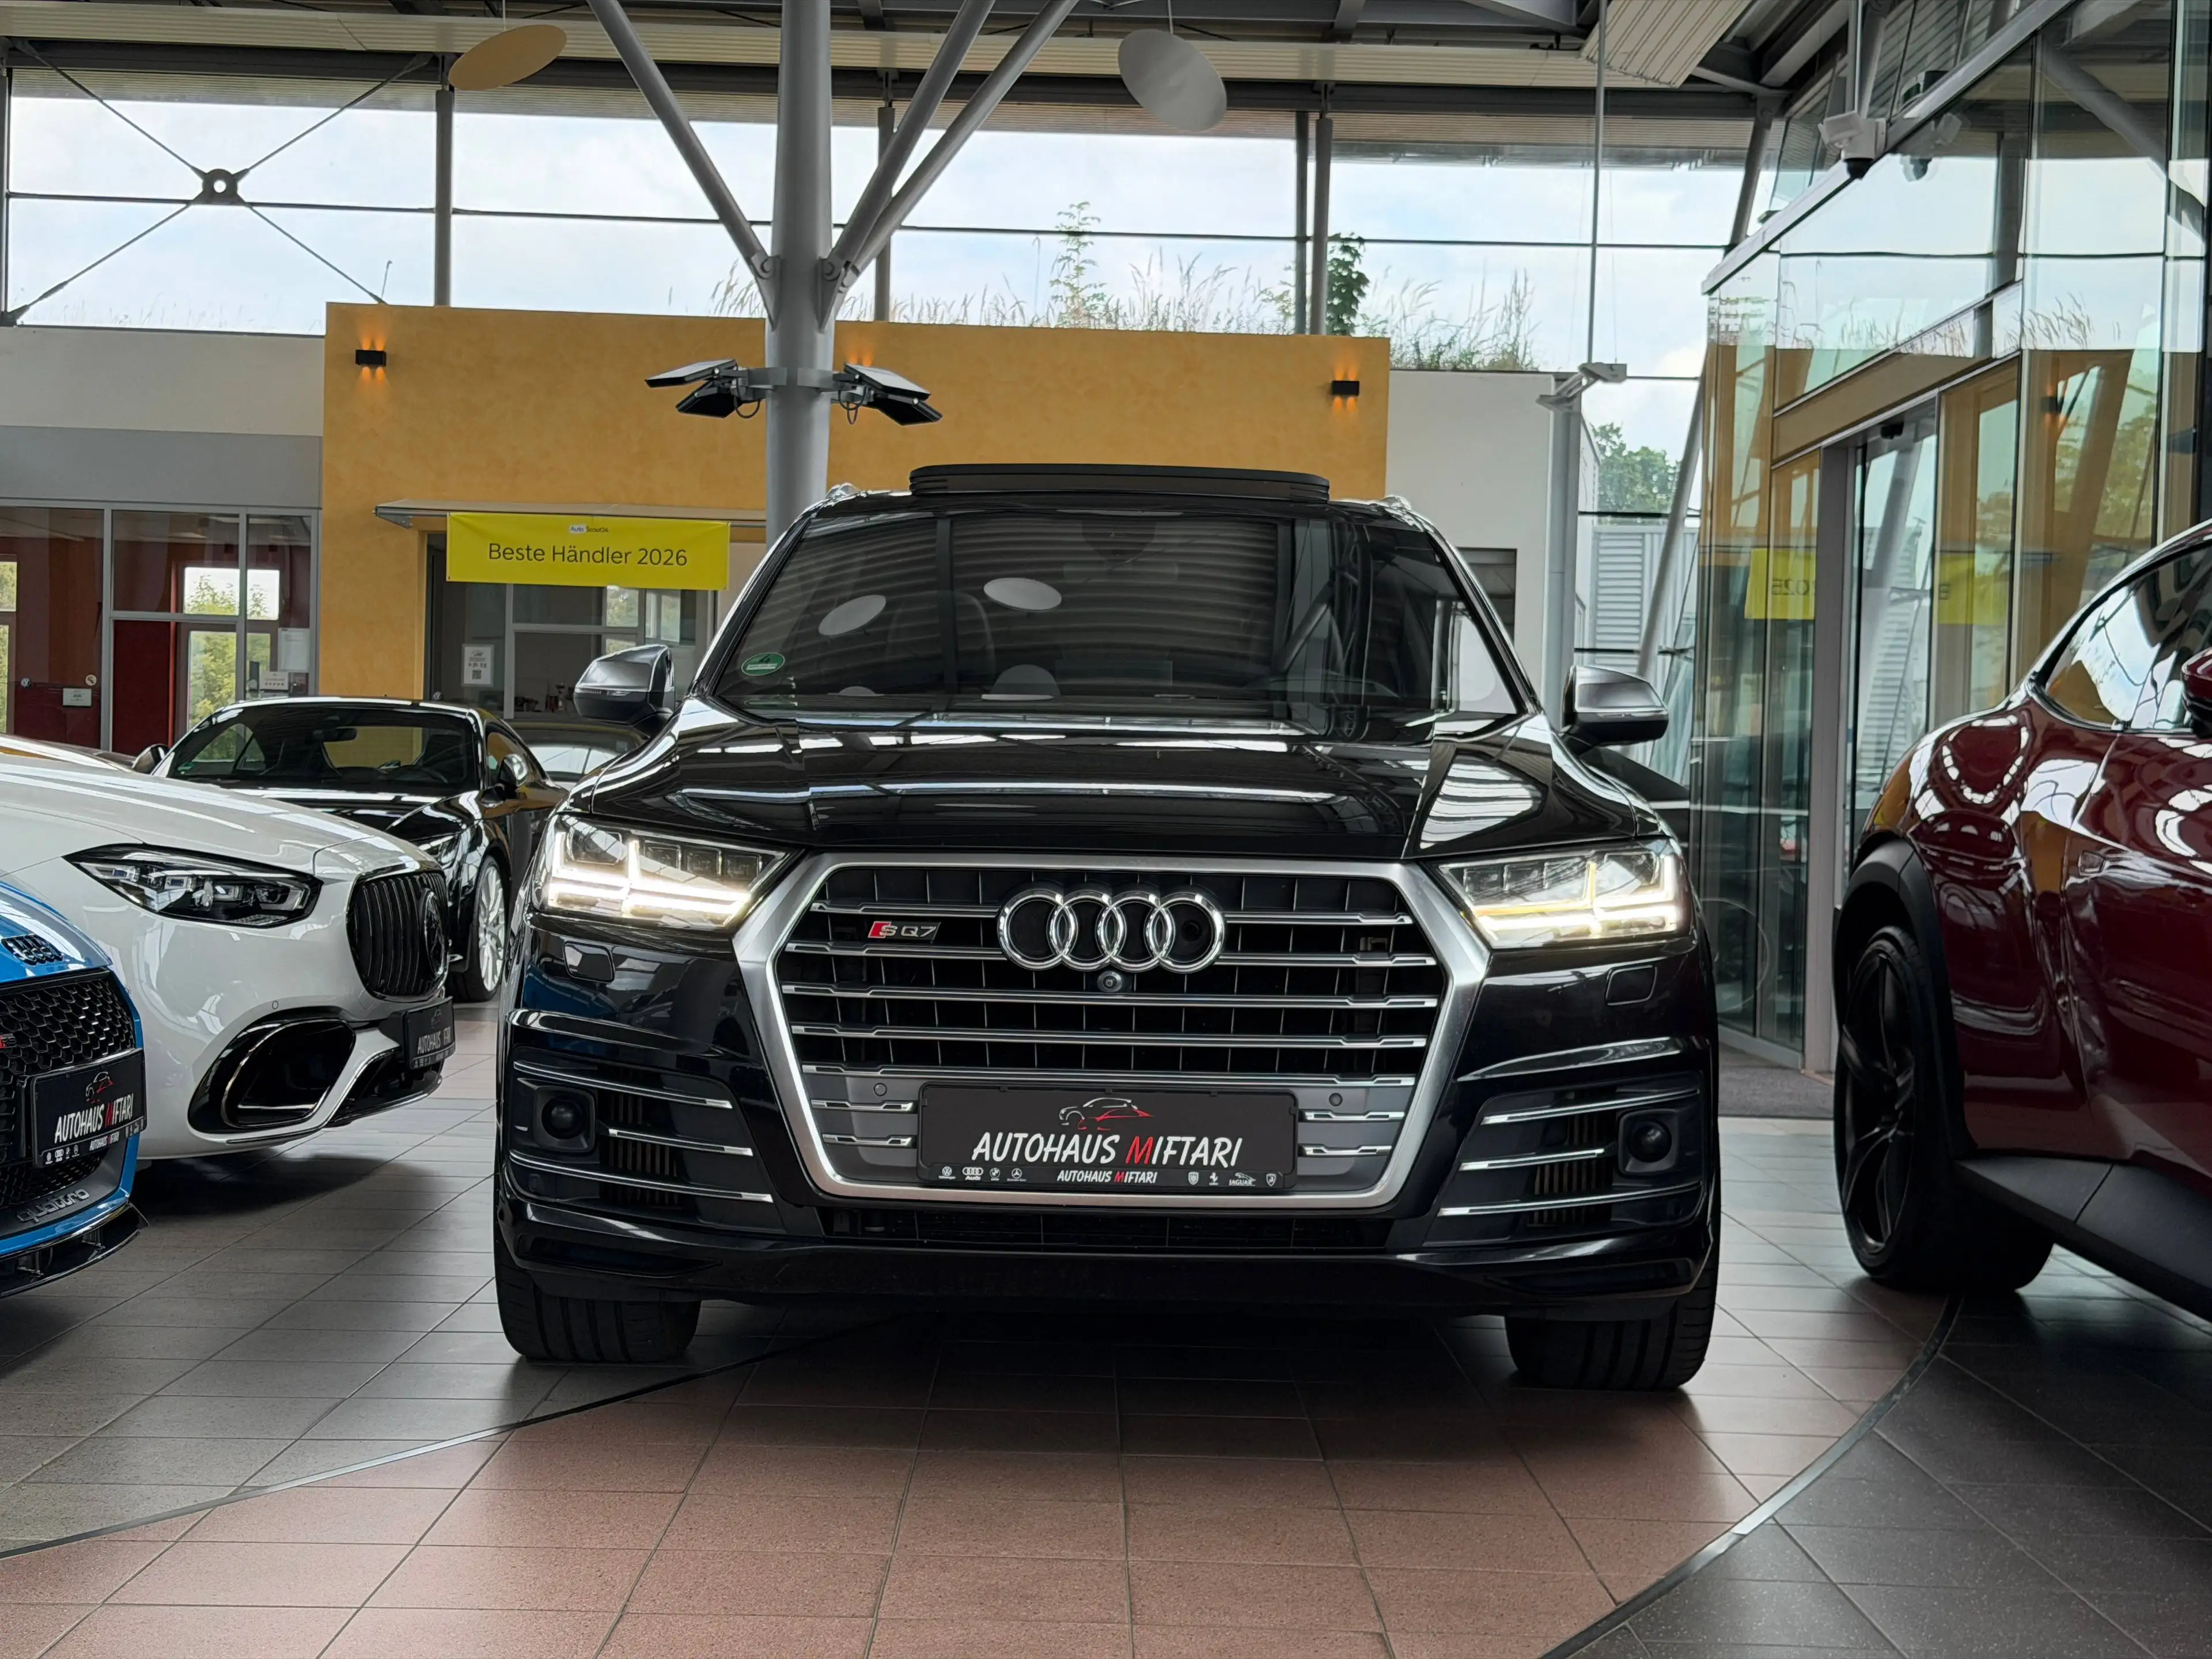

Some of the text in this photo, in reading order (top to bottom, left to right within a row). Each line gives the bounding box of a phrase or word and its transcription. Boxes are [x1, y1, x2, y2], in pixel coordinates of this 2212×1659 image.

[488, 543, 687, 566] Beste Händler 2026
[417, 1031, 441, 1055] AUTOHAUS
[54, 1093, 134, 1144] AUTOHAUS MIFTARI
[971, 1132, 1243, 1168] AUTOHAUS MIFTARI
[1056, 1169, 1158, 1184] AUTOHAUS MIFTARI
[16, 1188, 90, 1222] quattro
